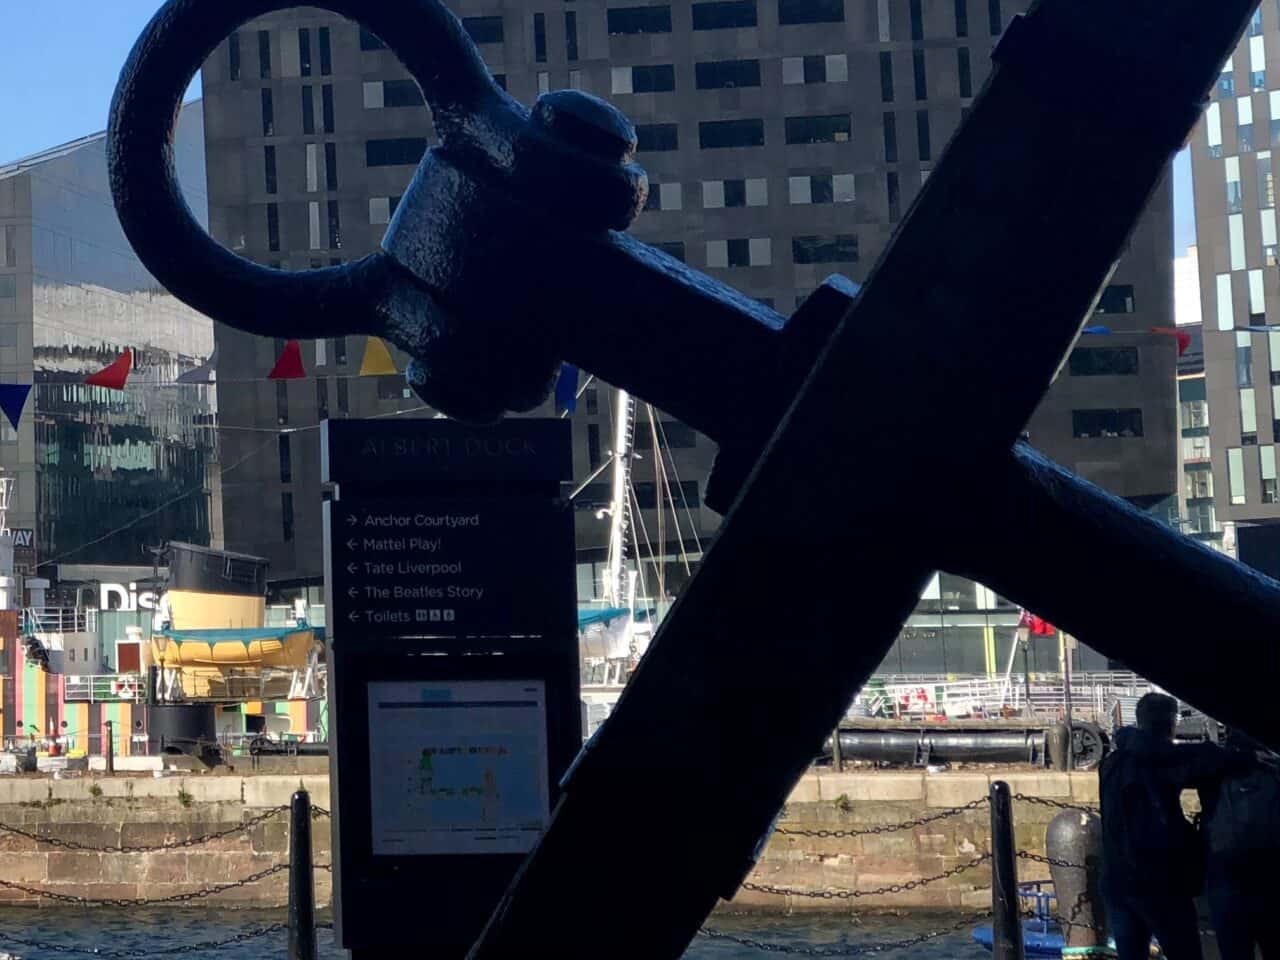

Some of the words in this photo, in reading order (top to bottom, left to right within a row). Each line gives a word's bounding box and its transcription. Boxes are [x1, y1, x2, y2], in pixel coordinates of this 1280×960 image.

[364, 514, 411, 527] Anchor
[414, 514, 480, 528] Courtyard
[363, 538, 406, 551] Mattel
[409, 538, 442, 553] Play!
[364, 562, 394, 575] Tate
[398, 561, 462, 576] Liverpool
[365, 586, 390, 599] The
[394, 586, 443, 598] Beatles
[447, 586, 484, 600] Story
[366, 610, 411, 623] Toilets
